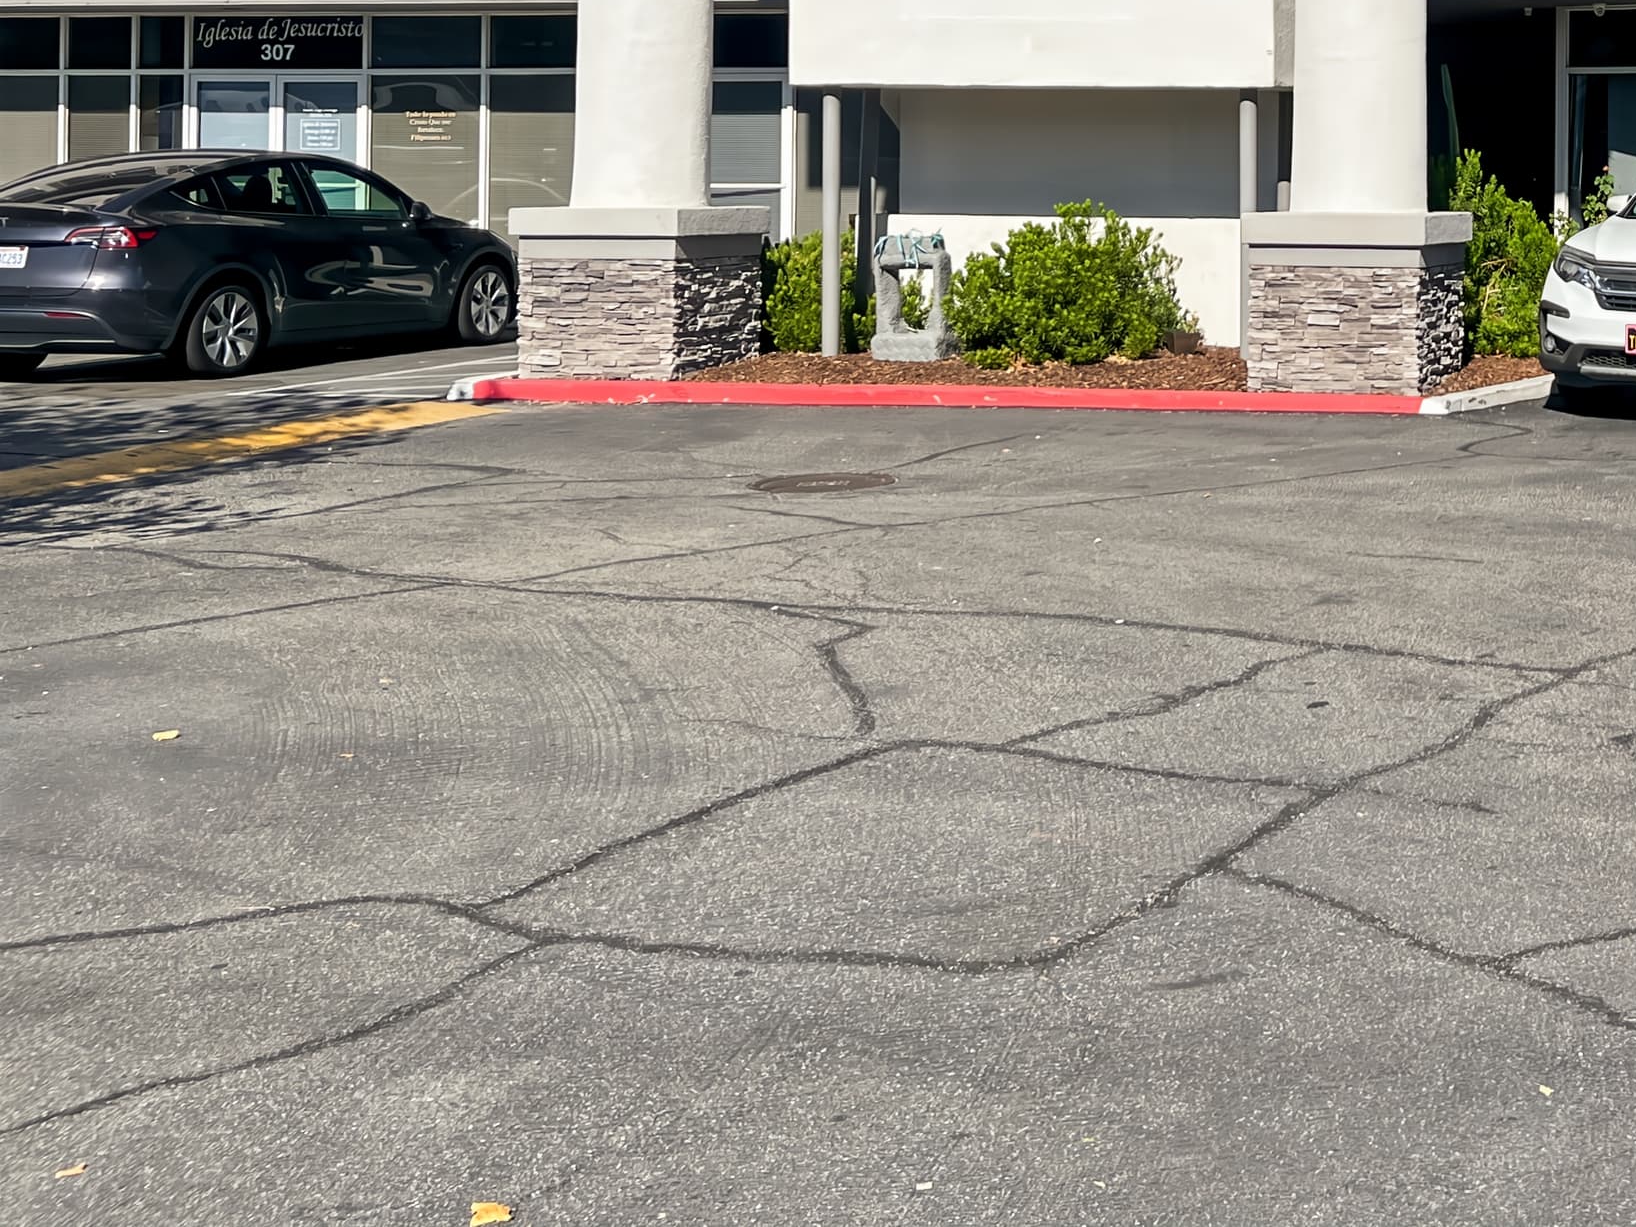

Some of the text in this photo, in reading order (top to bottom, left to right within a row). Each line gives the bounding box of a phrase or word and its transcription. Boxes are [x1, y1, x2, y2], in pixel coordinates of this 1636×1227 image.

[196, 17, 364, 48] Iglesia de Jesucristo
[260, 43, 295, 61] 307
